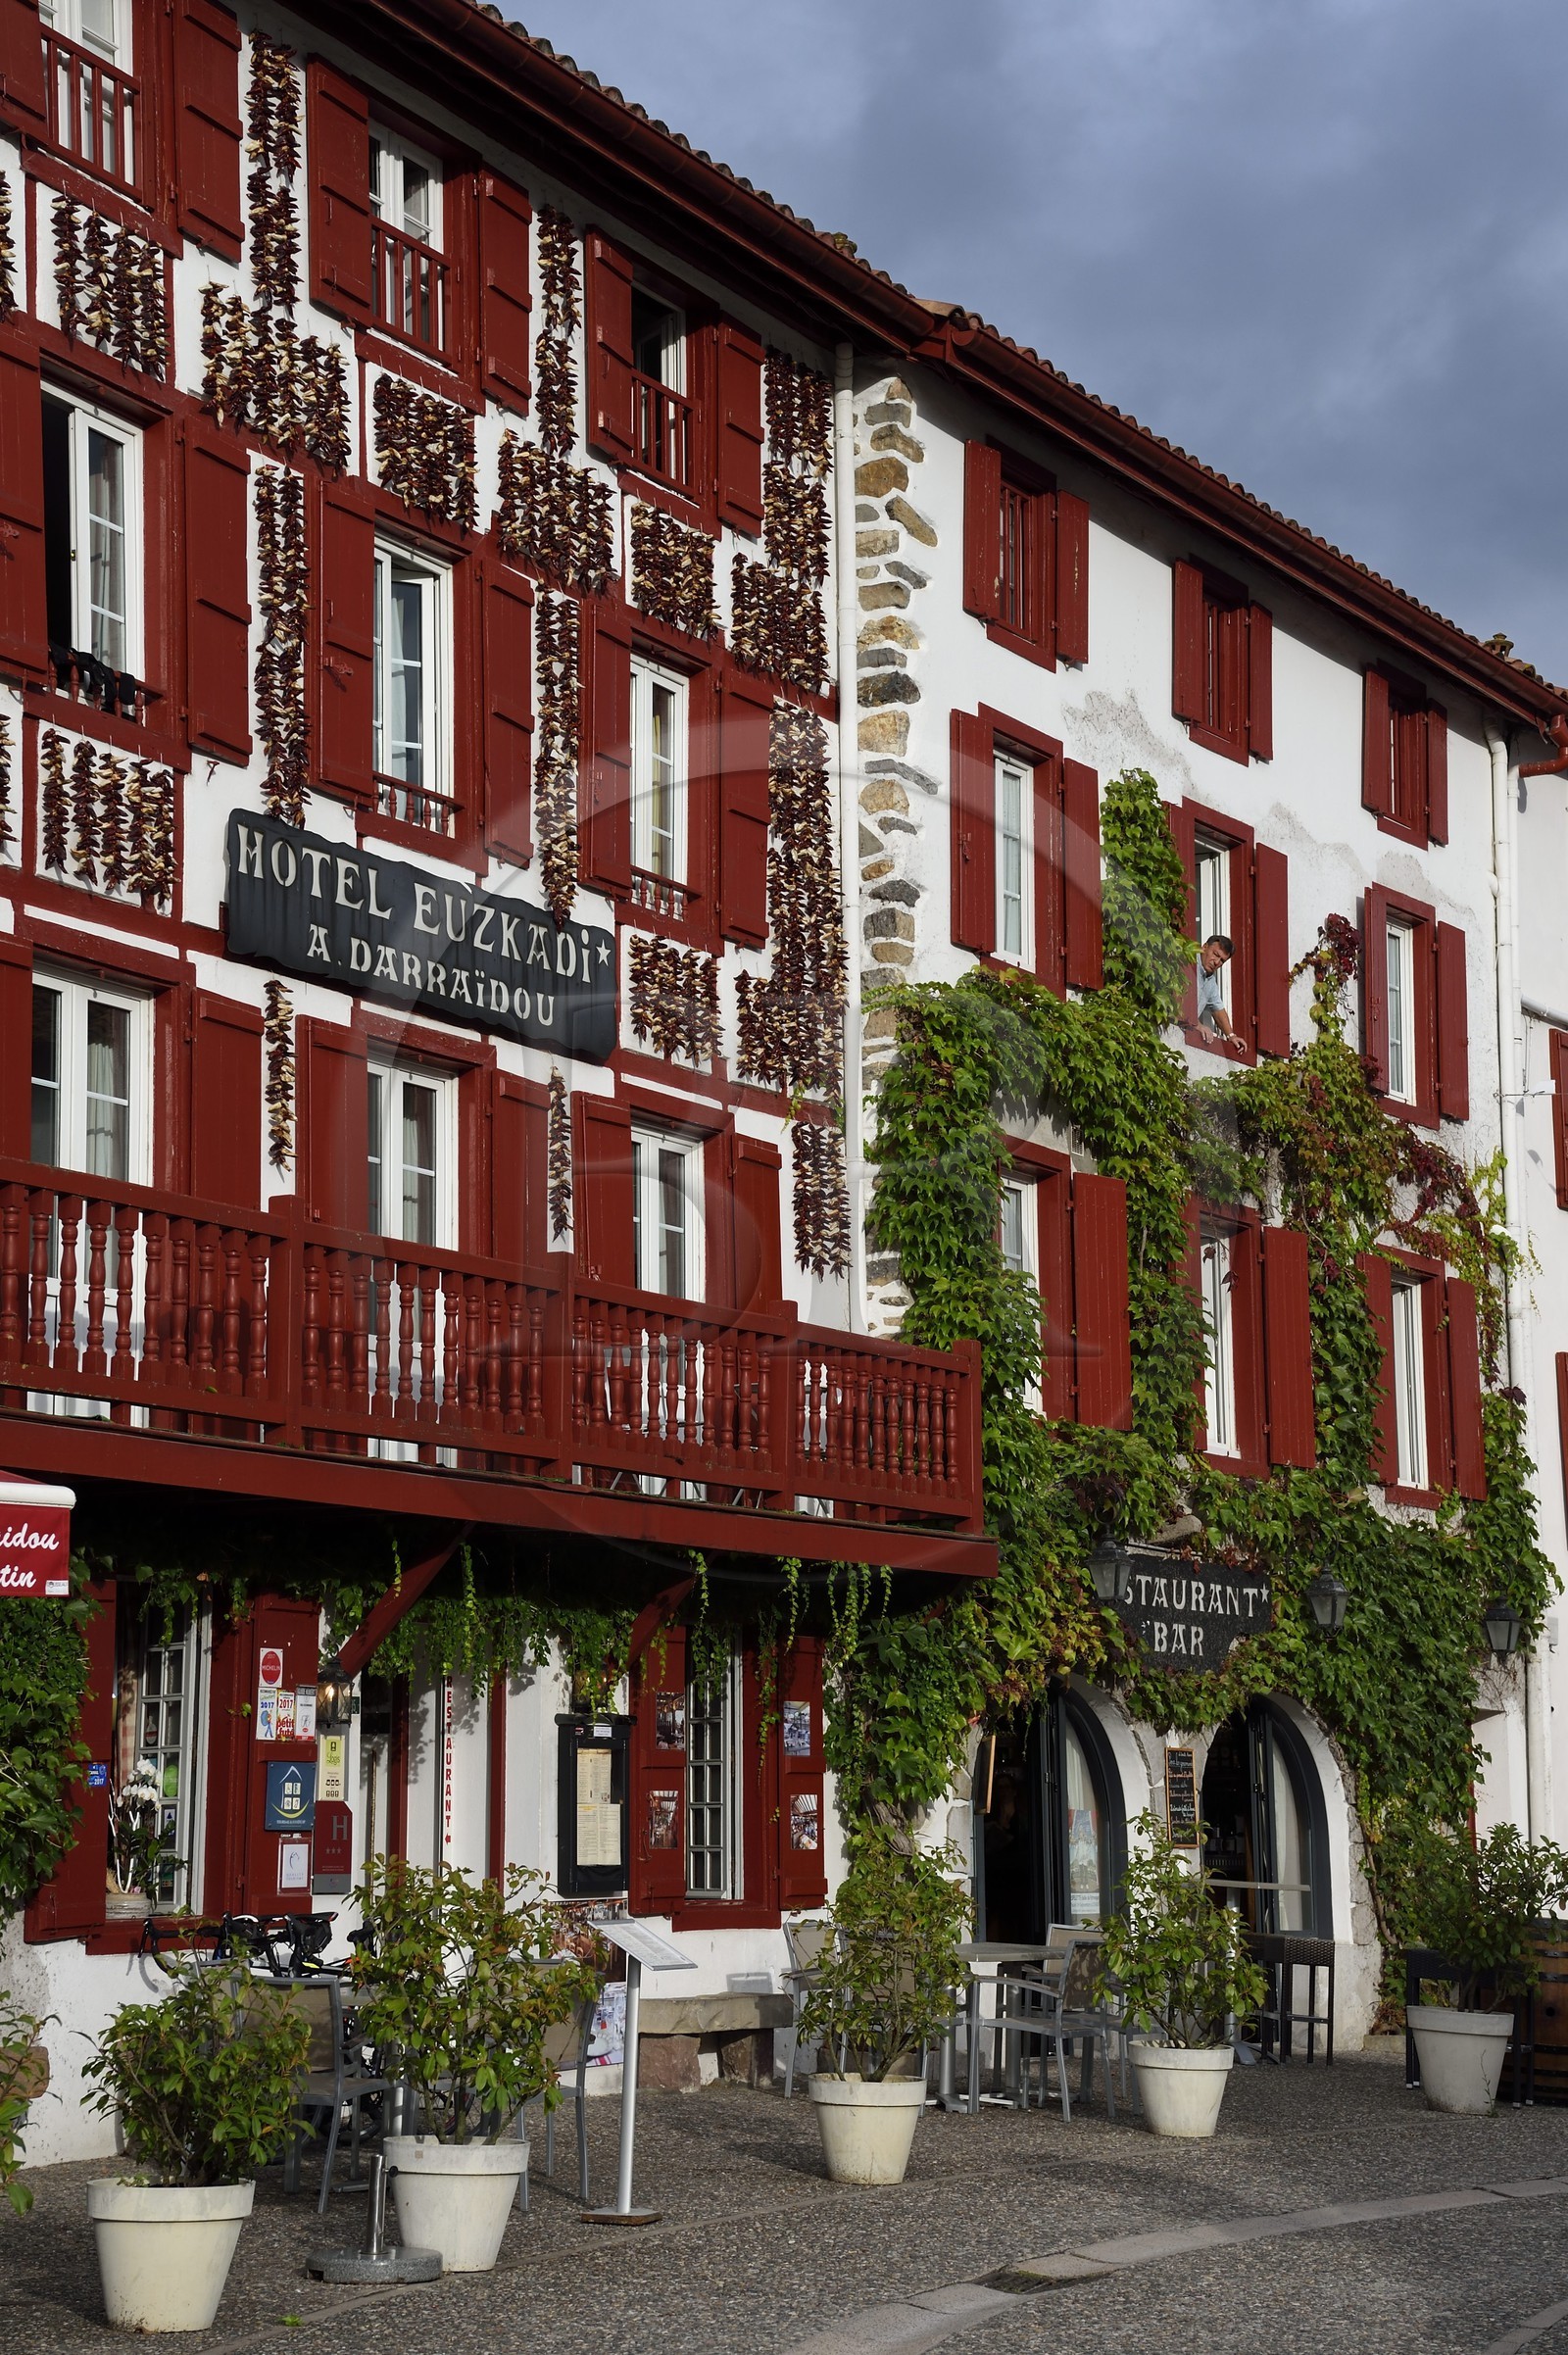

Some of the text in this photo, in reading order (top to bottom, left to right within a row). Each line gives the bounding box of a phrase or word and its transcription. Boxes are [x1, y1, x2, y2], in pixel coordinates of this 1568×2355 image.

[237, 823, 392, 920] HOTEL
[351, 942, 555, 1027] DARRAÏDOU
[0, 1522, 60, 1550] idou
[1153, 1621, 1204, 1657] BAR
[279, 1699, 293, 1708] 2017
[332, 1815, 348, 1840] H
